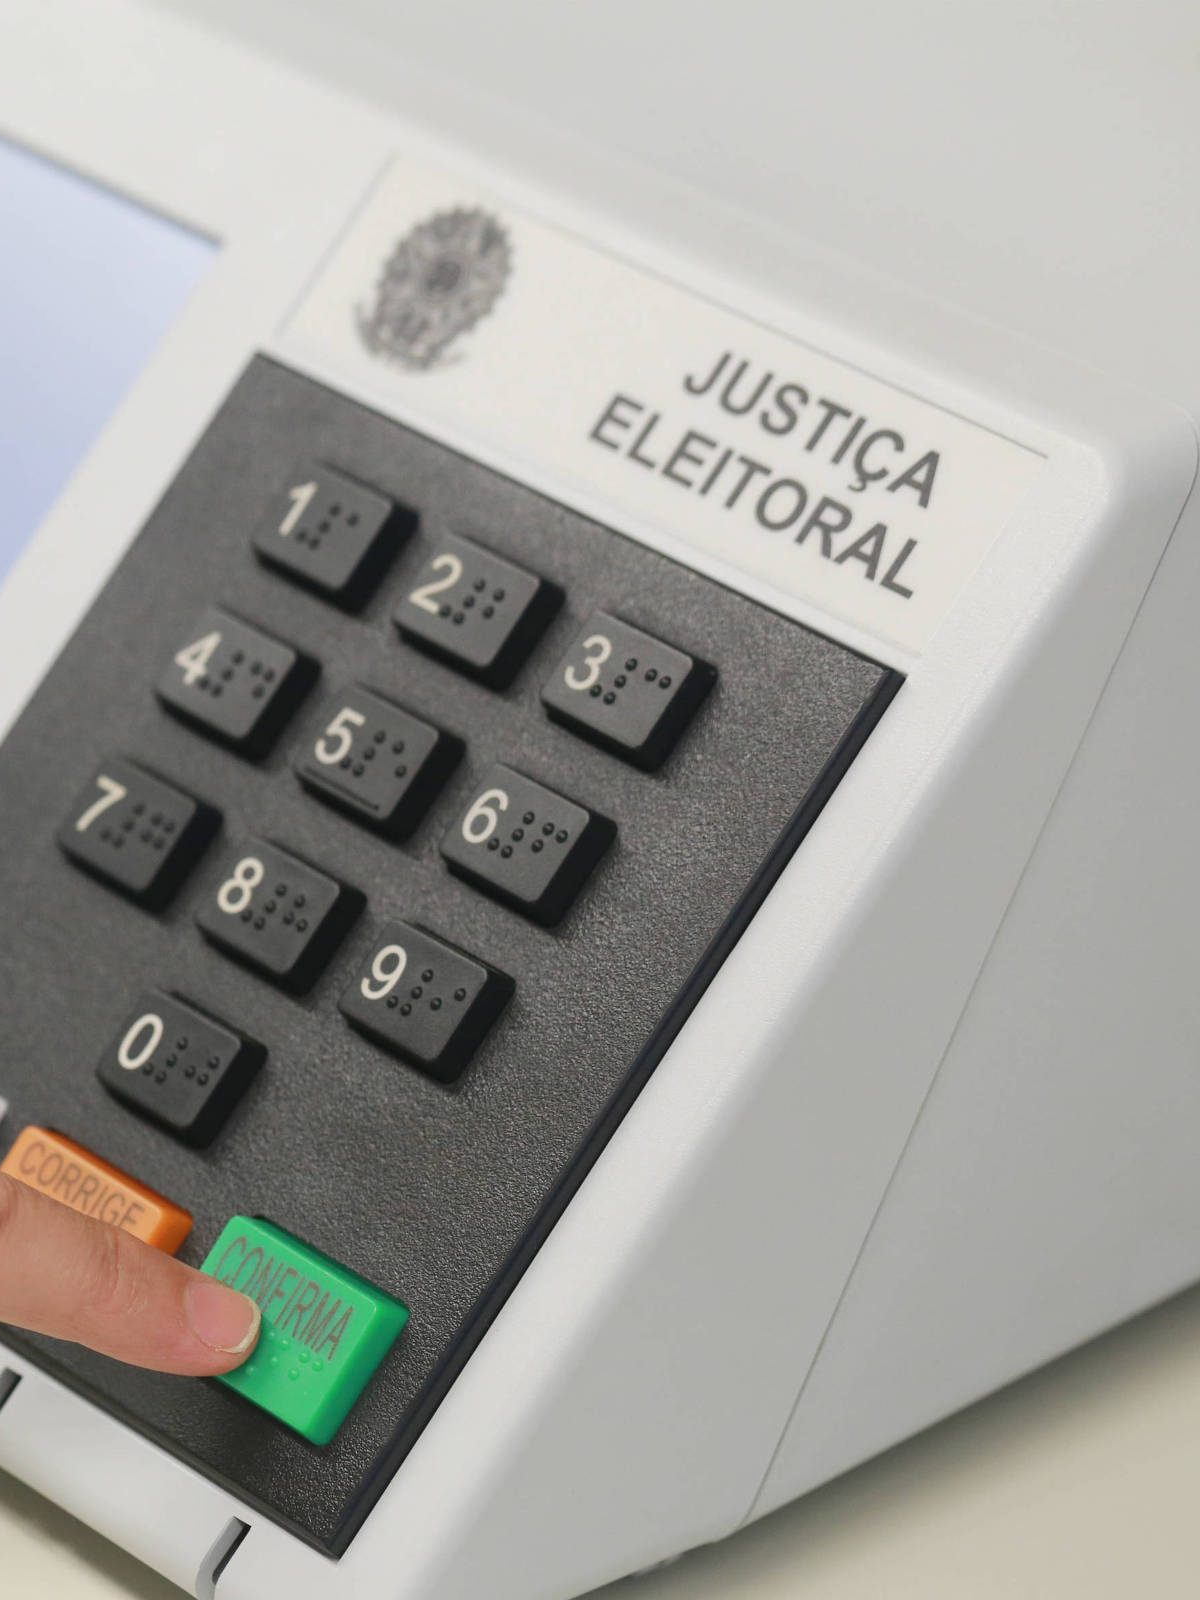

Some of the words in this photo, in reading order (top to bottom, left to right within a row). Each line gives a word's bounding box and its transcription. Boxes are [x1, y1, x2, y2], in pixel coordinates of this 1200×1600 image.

[684, 351, 942, 508] JUSTIÇA
[278, 481, 318, 536] 1
[589, 394, 919, 599] ELEITORAL
[409, 553, 463, 614] 2
[174, 631, 222, 686] 4
[564, 635, 612, 690] 3
[314, 707, 366, 764] 5
[75, 776, 127, 832] 7
[461, 788, 509, 844] 6
[216, 857, 264, 914] 8
[360, 944, 407, 1000] 9
[117, 1013, 164, 1070] 0
[18, 1140, 146, 1228] CORRIGE
[213, 1235, 355, 1361] CONFIRMA
